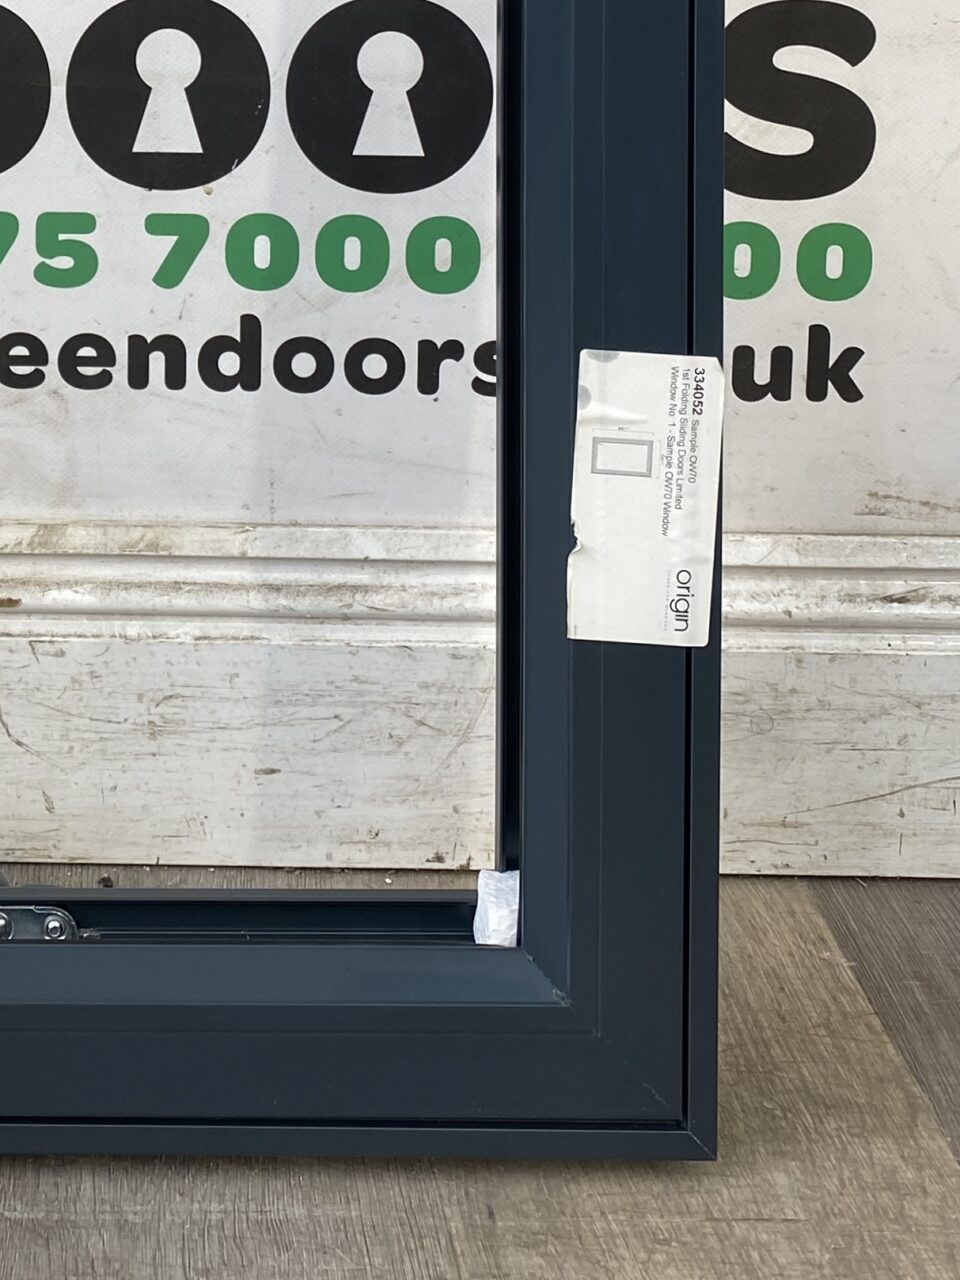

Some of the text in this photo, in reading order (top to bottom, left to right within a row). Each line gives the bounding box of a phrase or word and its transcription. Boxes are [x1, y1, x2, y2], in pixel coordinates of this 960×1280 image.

[144, 213, 481, 294] 7000
[669, 366, 680, 401] Window
[692, 367, 705, 416] 334052
[665, 435, 676, 469] Sample
[674, 368, 690, 510] 1st Folding Sliding Doors Limited
[689, 419, 700, 453] Sample
[660, 501, 672, 537] Window
[669, 569, 695, 632] origin
